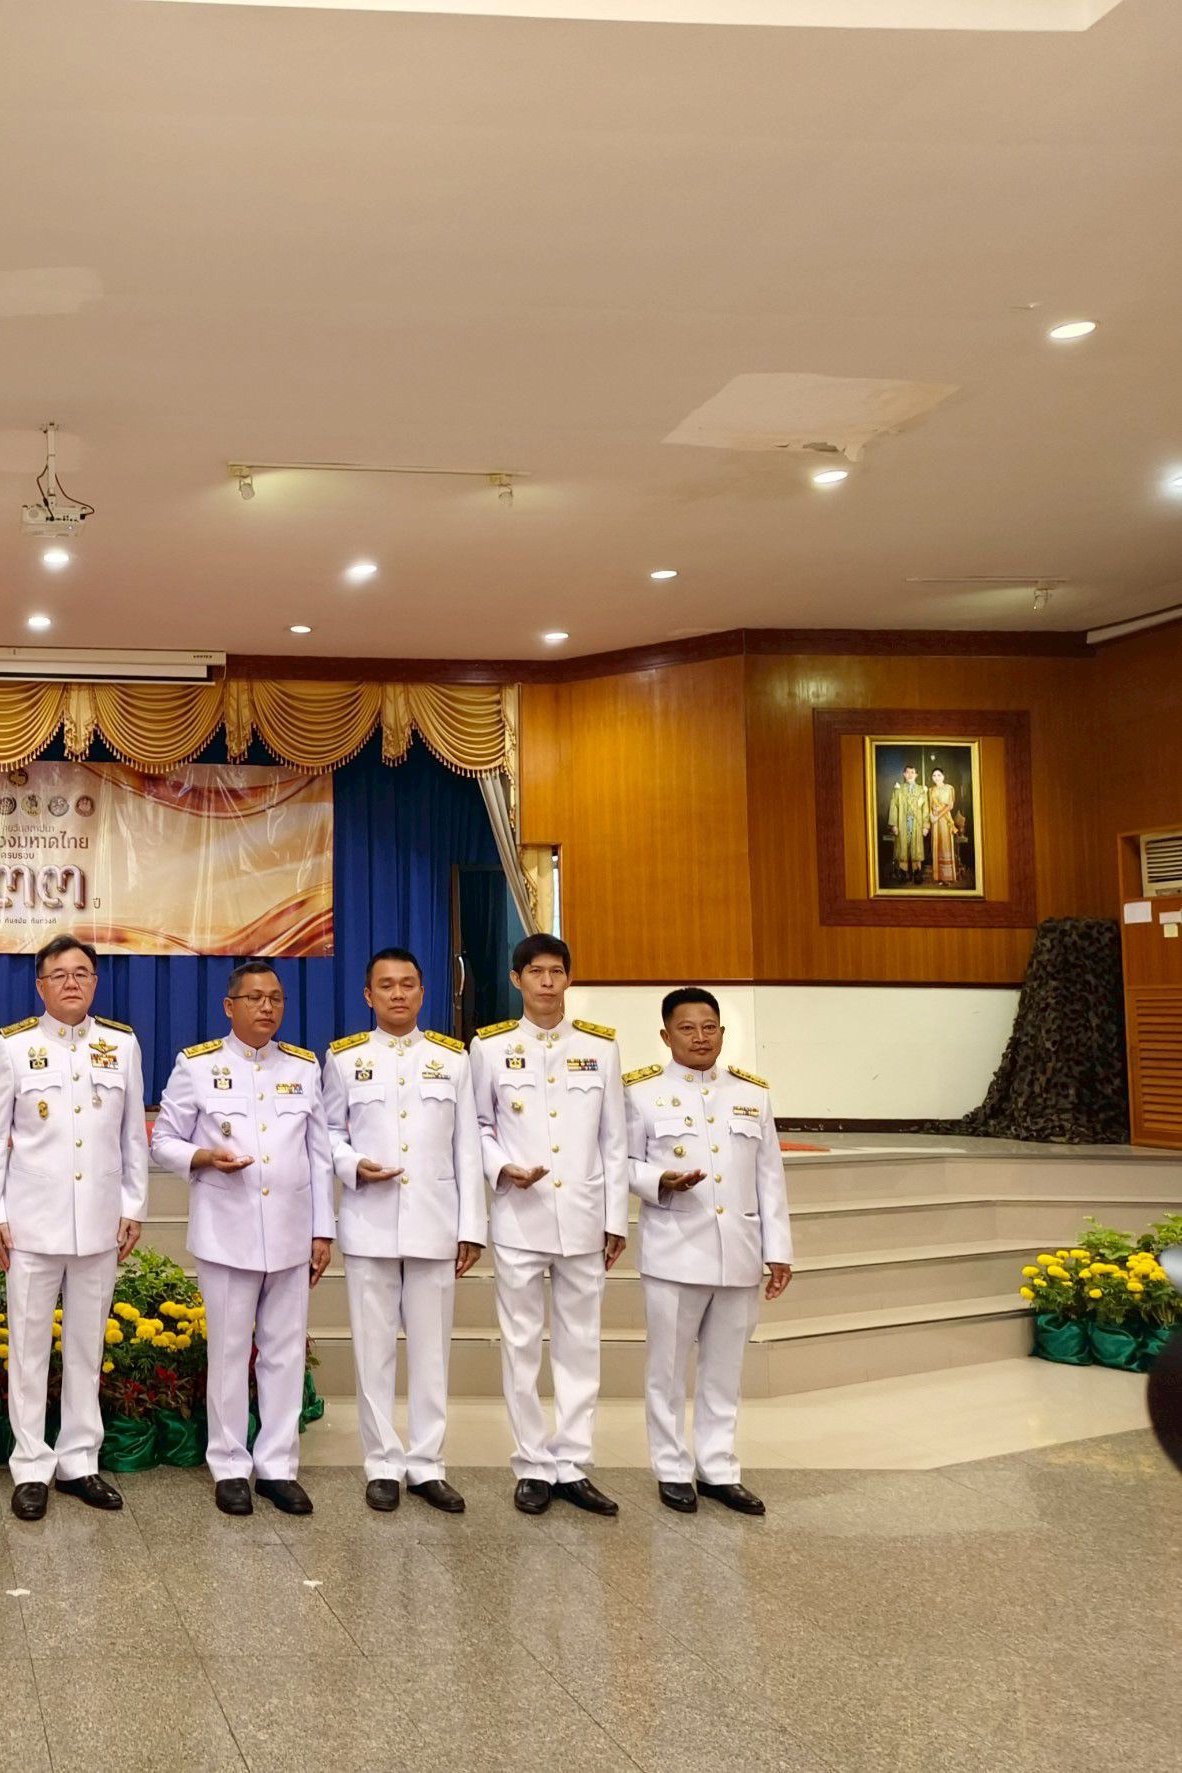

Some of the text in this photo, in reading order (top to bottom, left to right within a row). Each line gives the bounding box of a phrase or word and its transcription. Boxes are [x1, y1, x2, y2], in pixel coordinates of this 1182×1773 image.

[0, 852, 35, 860] ครบรอบ
[92, 897, 101, 910] ปี
